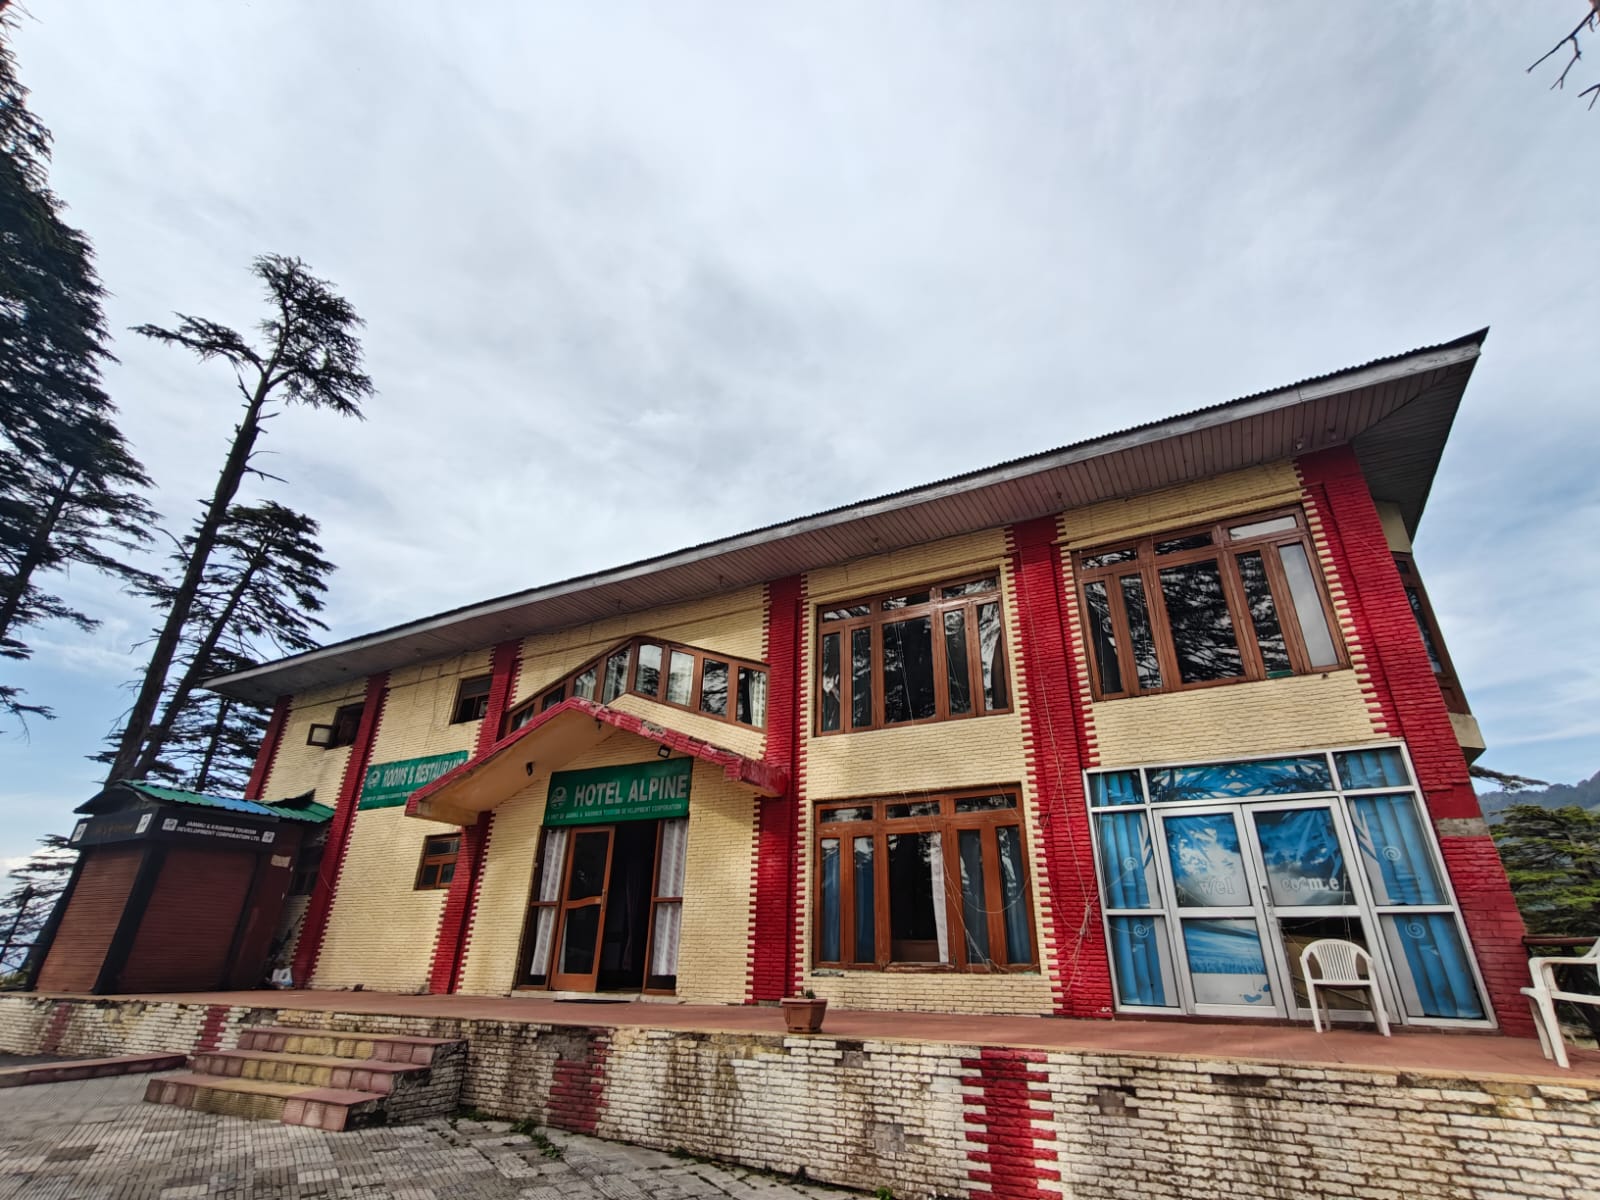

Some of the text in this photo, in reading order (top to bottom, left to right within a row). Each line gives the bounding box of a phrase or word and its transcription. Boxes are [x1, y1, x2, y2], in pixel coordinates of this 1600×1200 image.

[383, 766, 408, 788] ROOMS
[573, 775, 688, 807] HOTEL ALPINE
